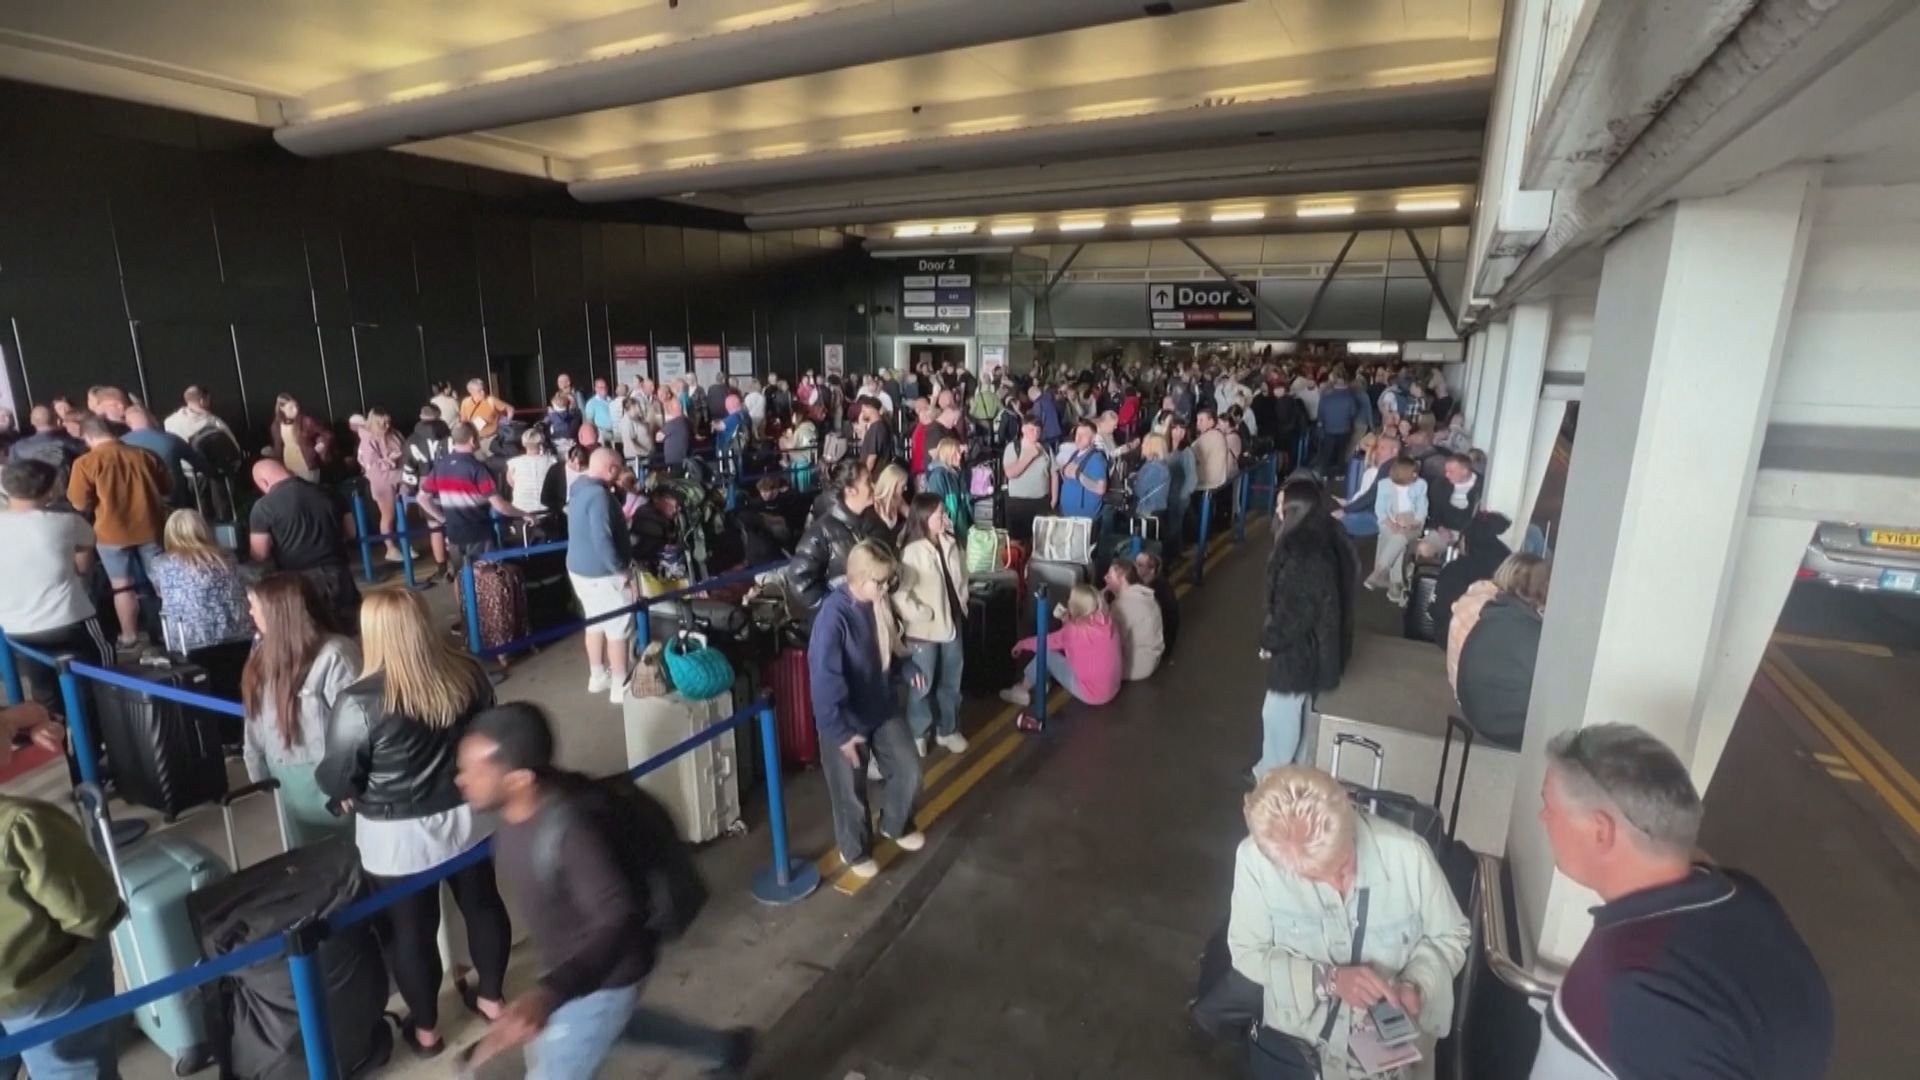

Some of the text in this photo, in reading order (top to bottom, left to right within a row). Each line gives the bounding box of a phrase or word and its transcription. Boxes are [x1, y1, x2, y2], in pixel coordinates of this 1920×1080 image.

[918, 258, 955, 271] Door 2
[1178, 287, 1231, 305] Door
[913, 322, 951, 334] Security
